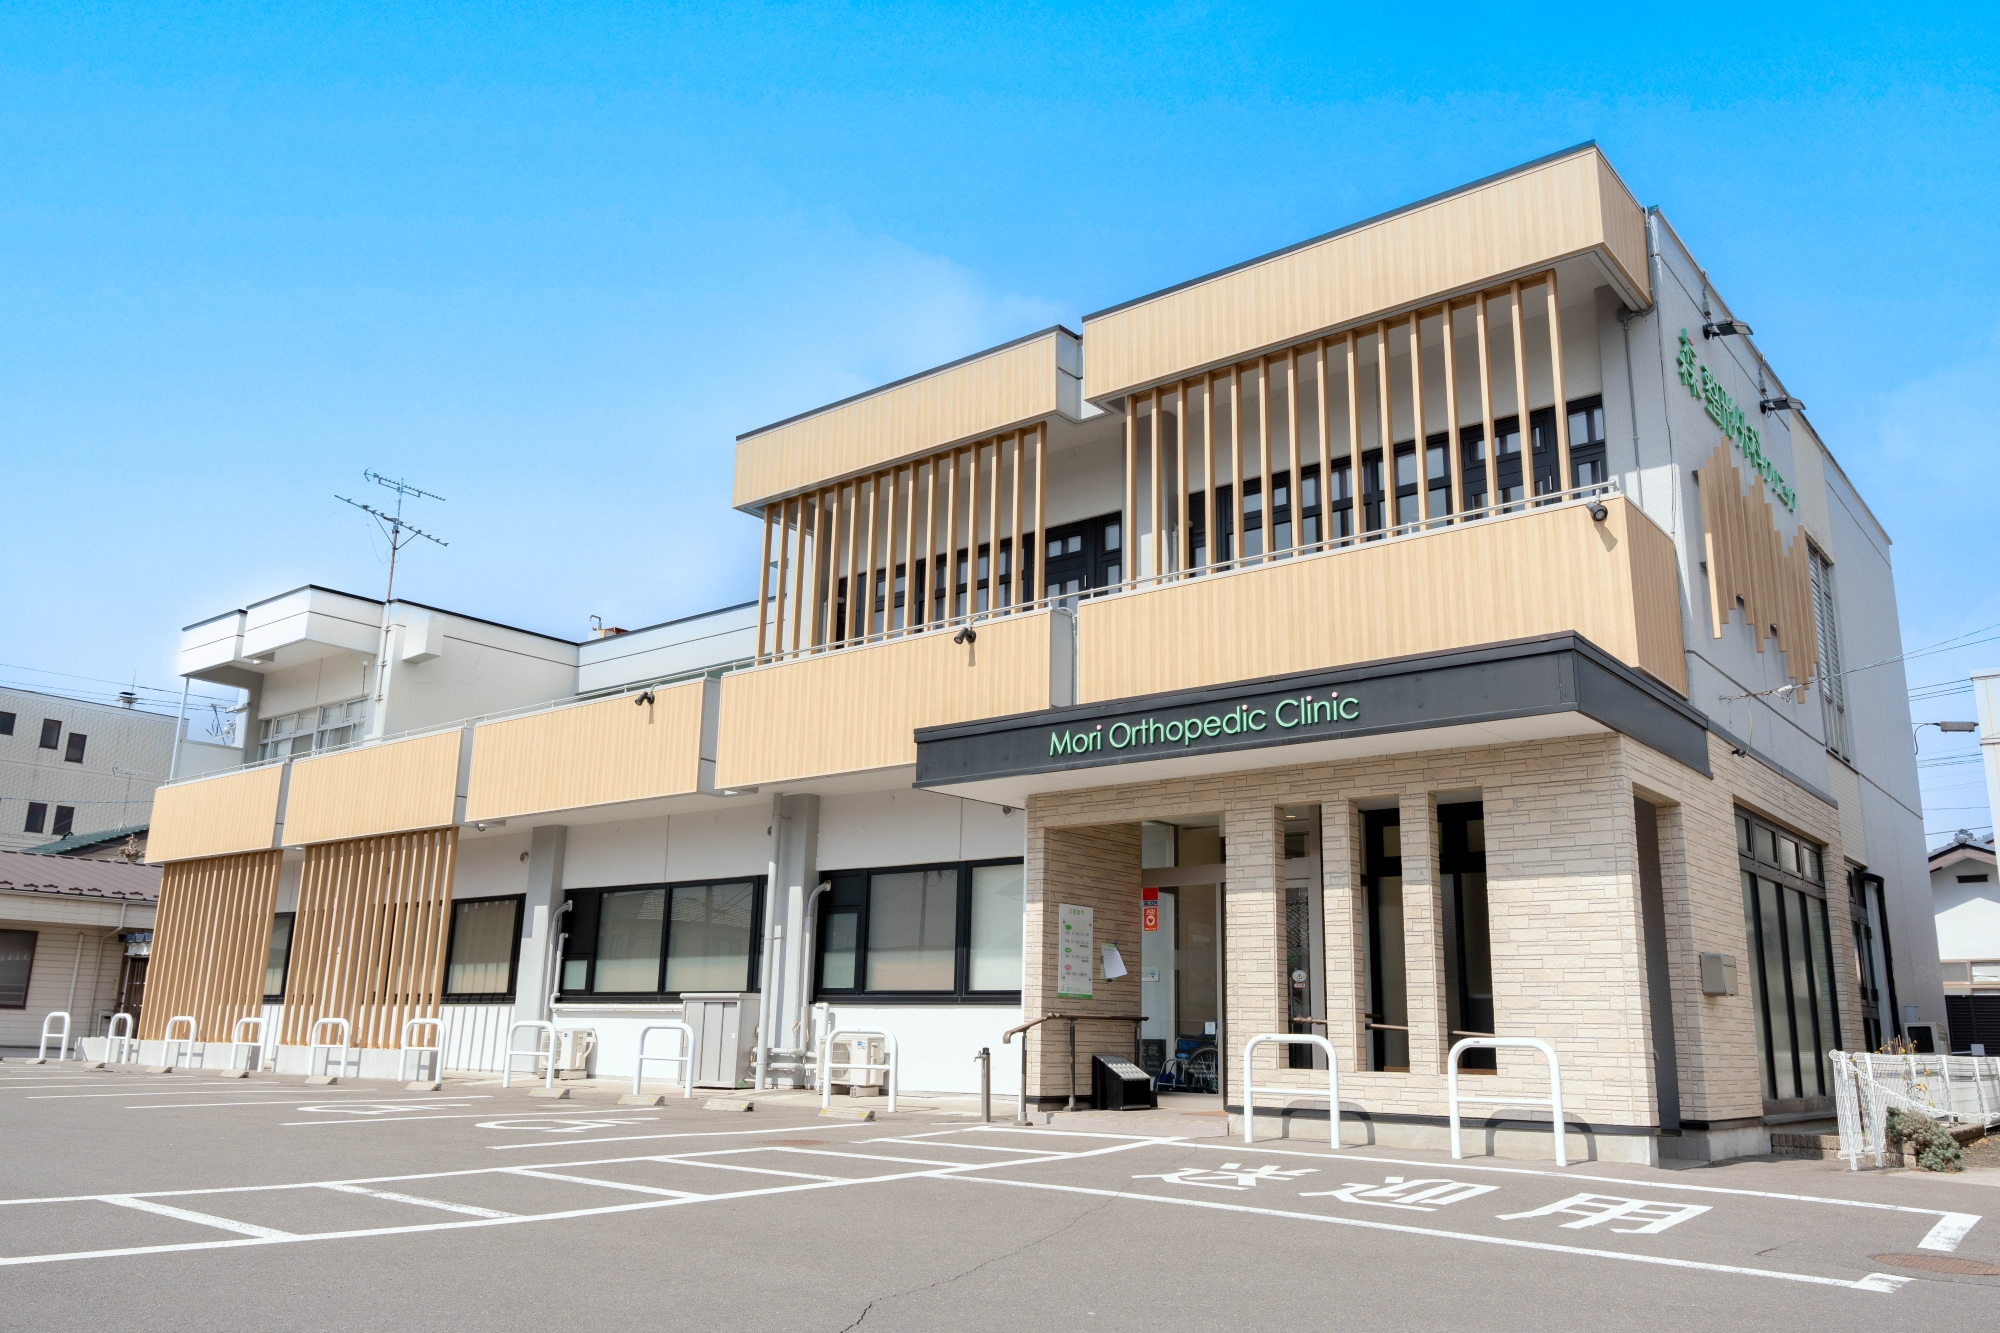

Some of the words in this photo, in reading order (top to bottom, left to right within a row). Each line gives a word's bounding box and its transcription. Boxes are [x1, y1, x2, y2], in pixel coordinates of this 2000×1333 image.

[1049, 724, 1102, 756] Mori
[1109, 704, 1267, 748] Orthopedic
[1275, 691, 1359, 727] Clinic
[1131, 1162, 1713, 1234] 送迎用
